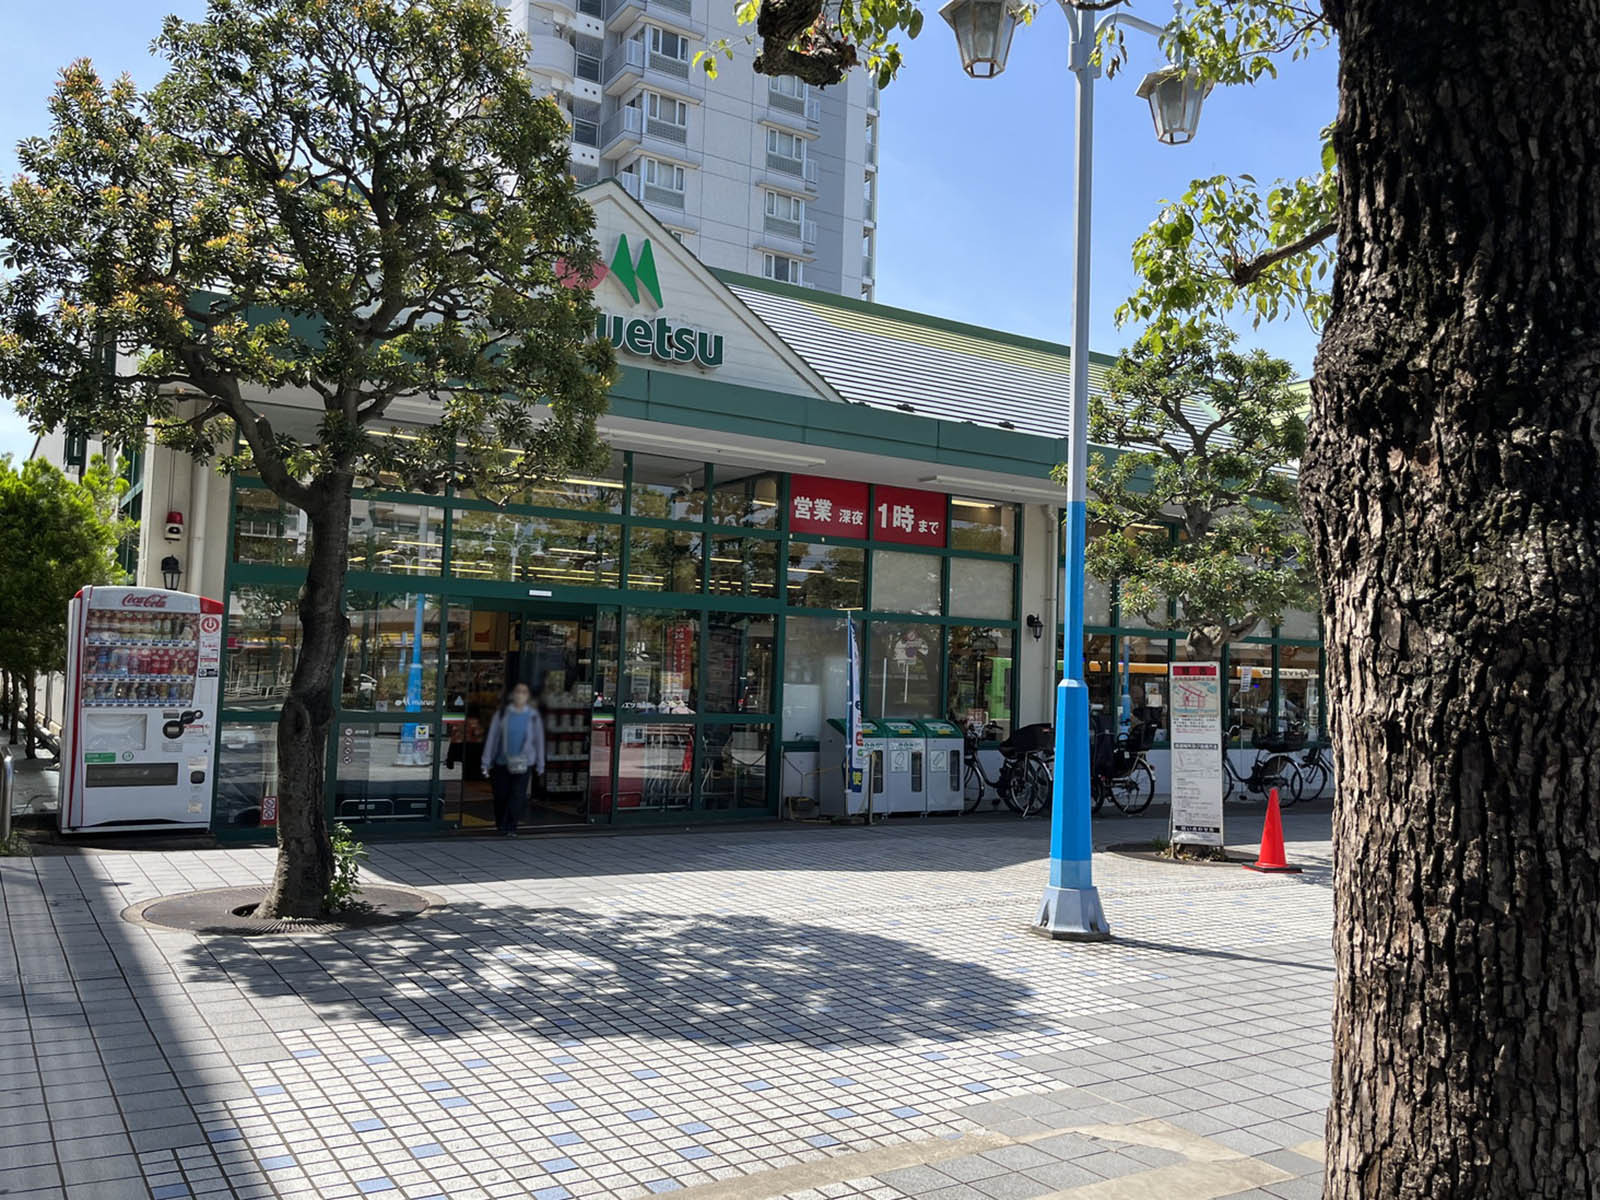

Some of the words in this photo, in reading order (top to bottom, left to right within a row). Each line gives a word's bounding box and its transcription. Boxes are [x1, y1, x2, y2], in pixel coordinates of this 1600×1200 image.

[594, 315, 723, 367] uetsu
[794, 496, 832, 522] 営業
[839, 509, 864, 525] 深夜
[878, 503, 915, 533] 1時
[918, 520, 940, 535] まで
